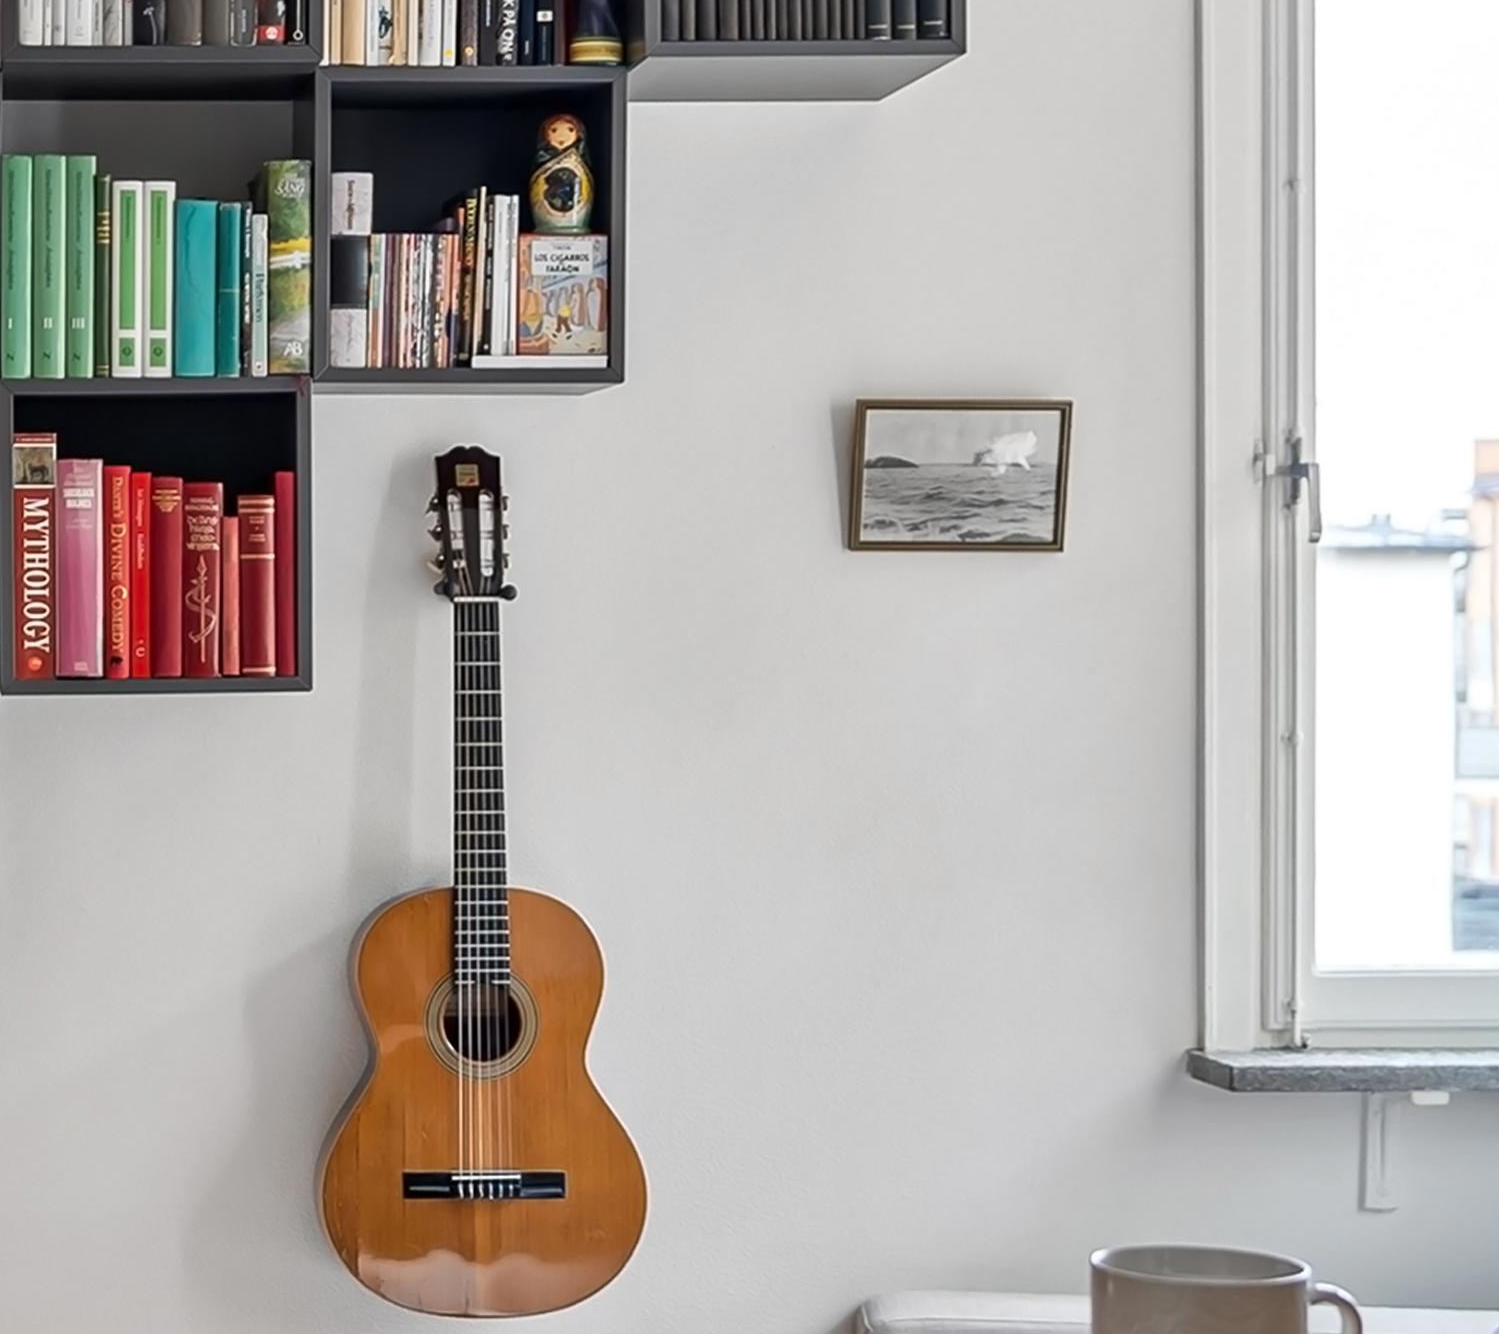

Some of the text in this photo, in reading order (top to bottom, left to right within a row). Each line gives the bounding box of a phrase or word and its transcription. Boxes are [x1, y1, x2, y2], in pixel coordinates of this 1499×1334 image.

[503, 10, 517, 26] PÅ
[22, 497, 50, 654] MYTHOLOGY
[110, 522, 127, 580] DIVINE
[110, 584, 128, 654] COMEDY
